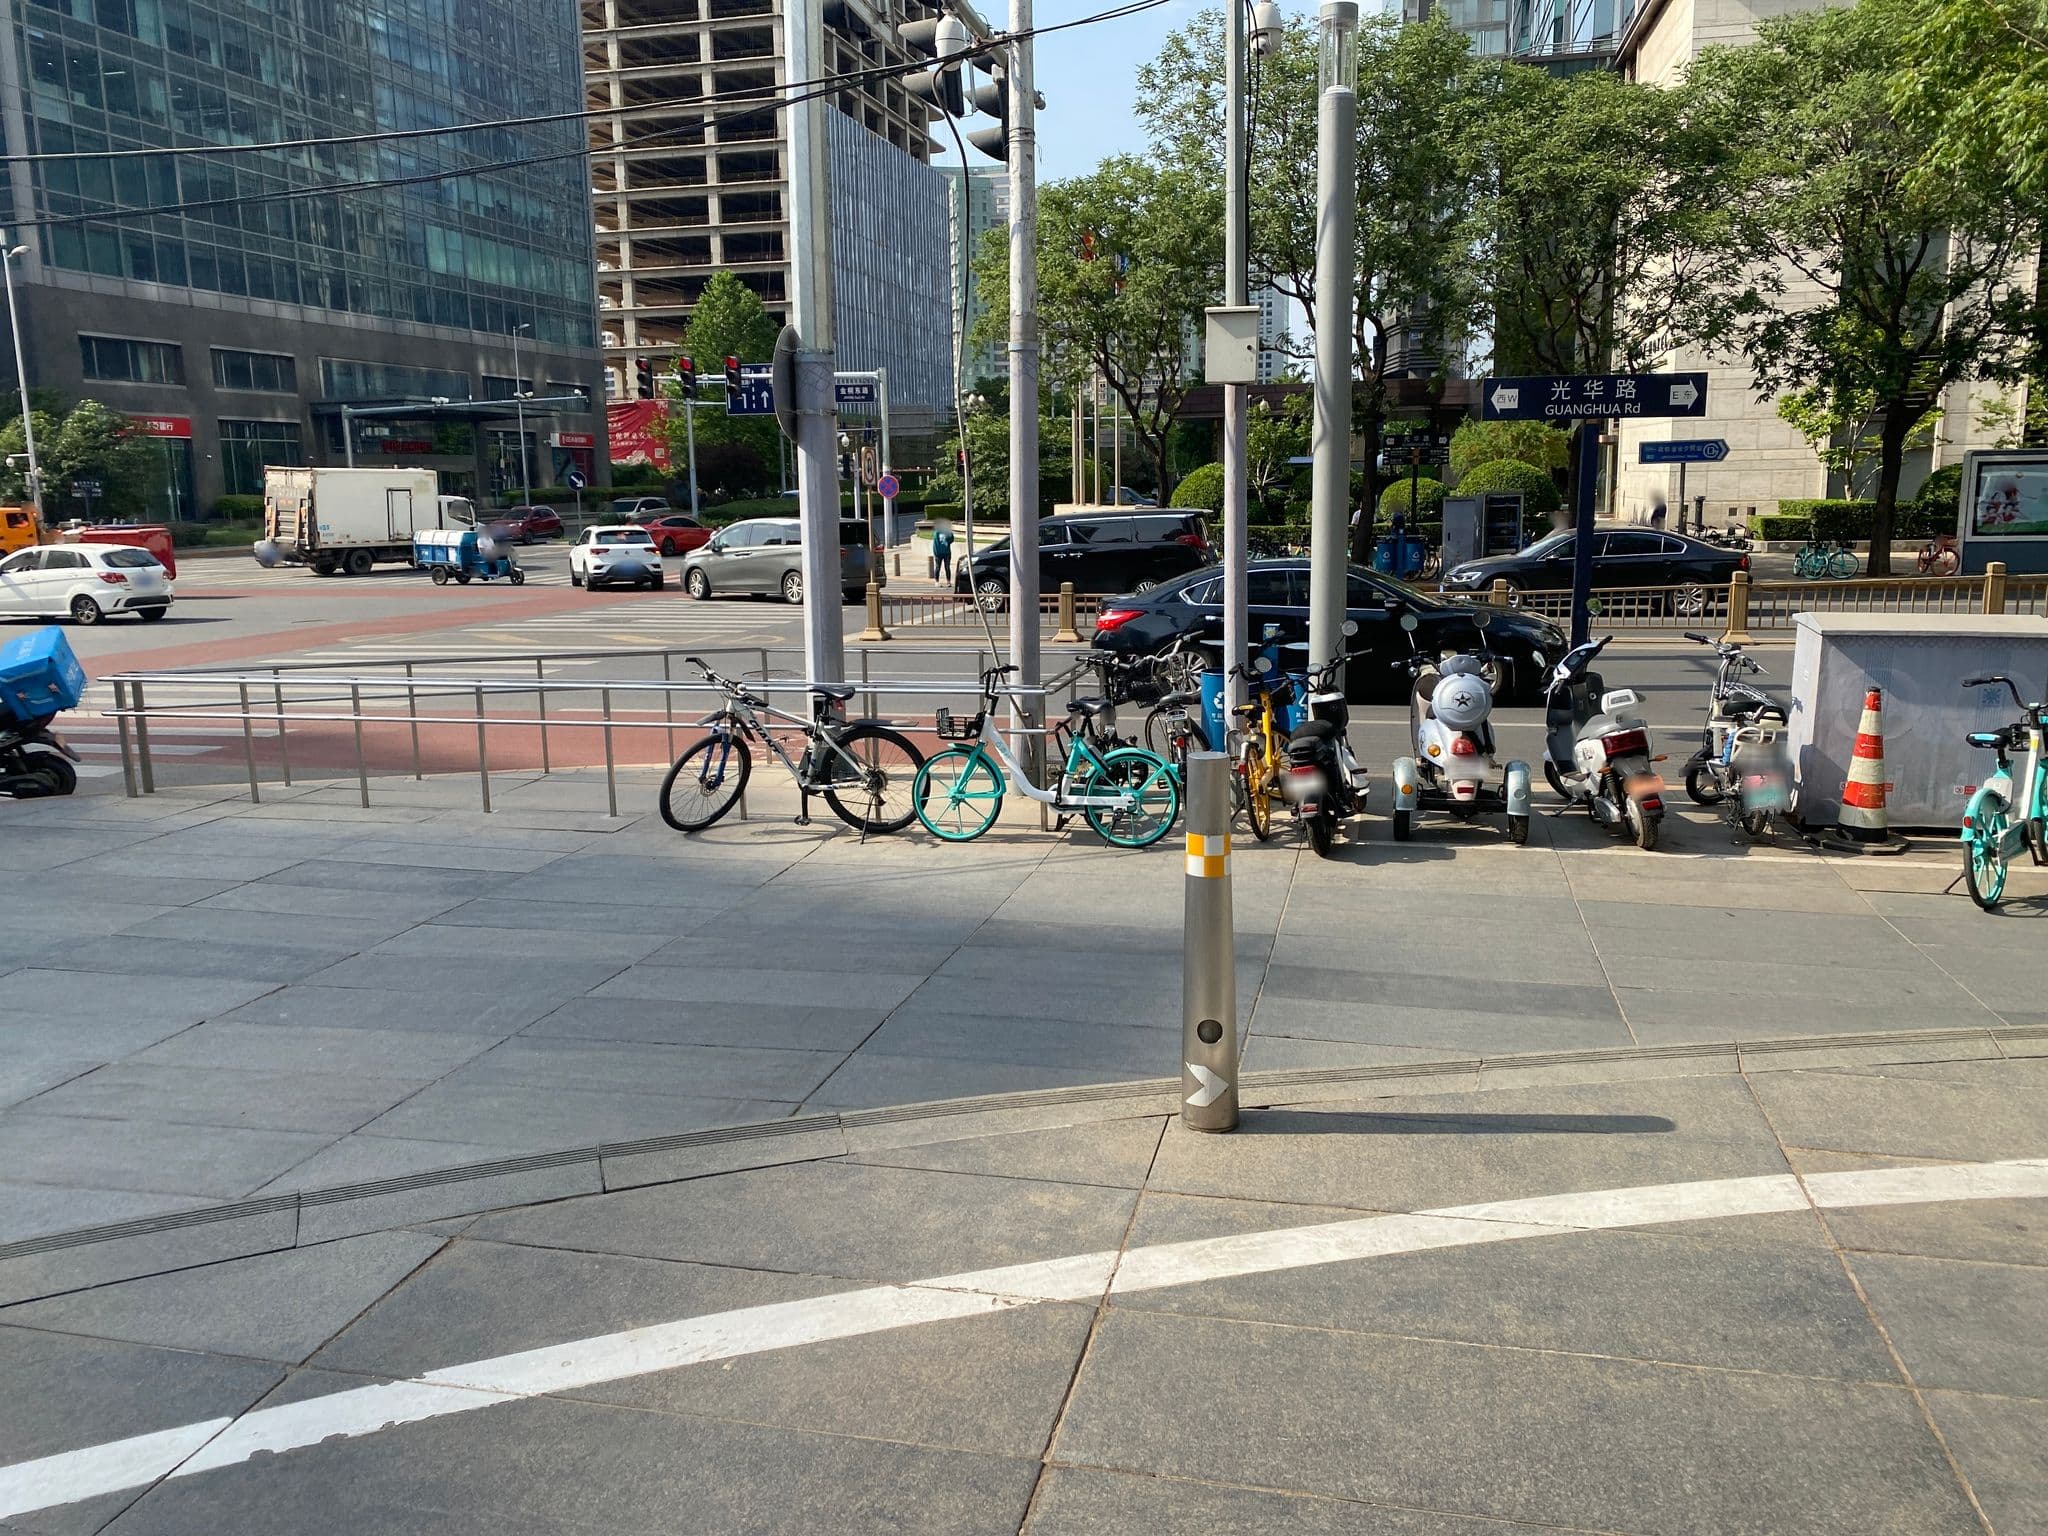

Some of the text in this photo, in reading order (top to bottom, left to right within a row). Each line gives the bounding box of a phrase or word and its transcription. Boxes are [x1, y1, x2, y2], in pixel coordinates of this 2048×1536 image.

[1551, 379, 1637, 400] 光华路
[1673, 391, 1679, 400] E
[1508, 394, 1517, 402] W
[1545, 403, 1641, 415] GUANGHUA Rd
[749, 719, 781, 754] GIANT
